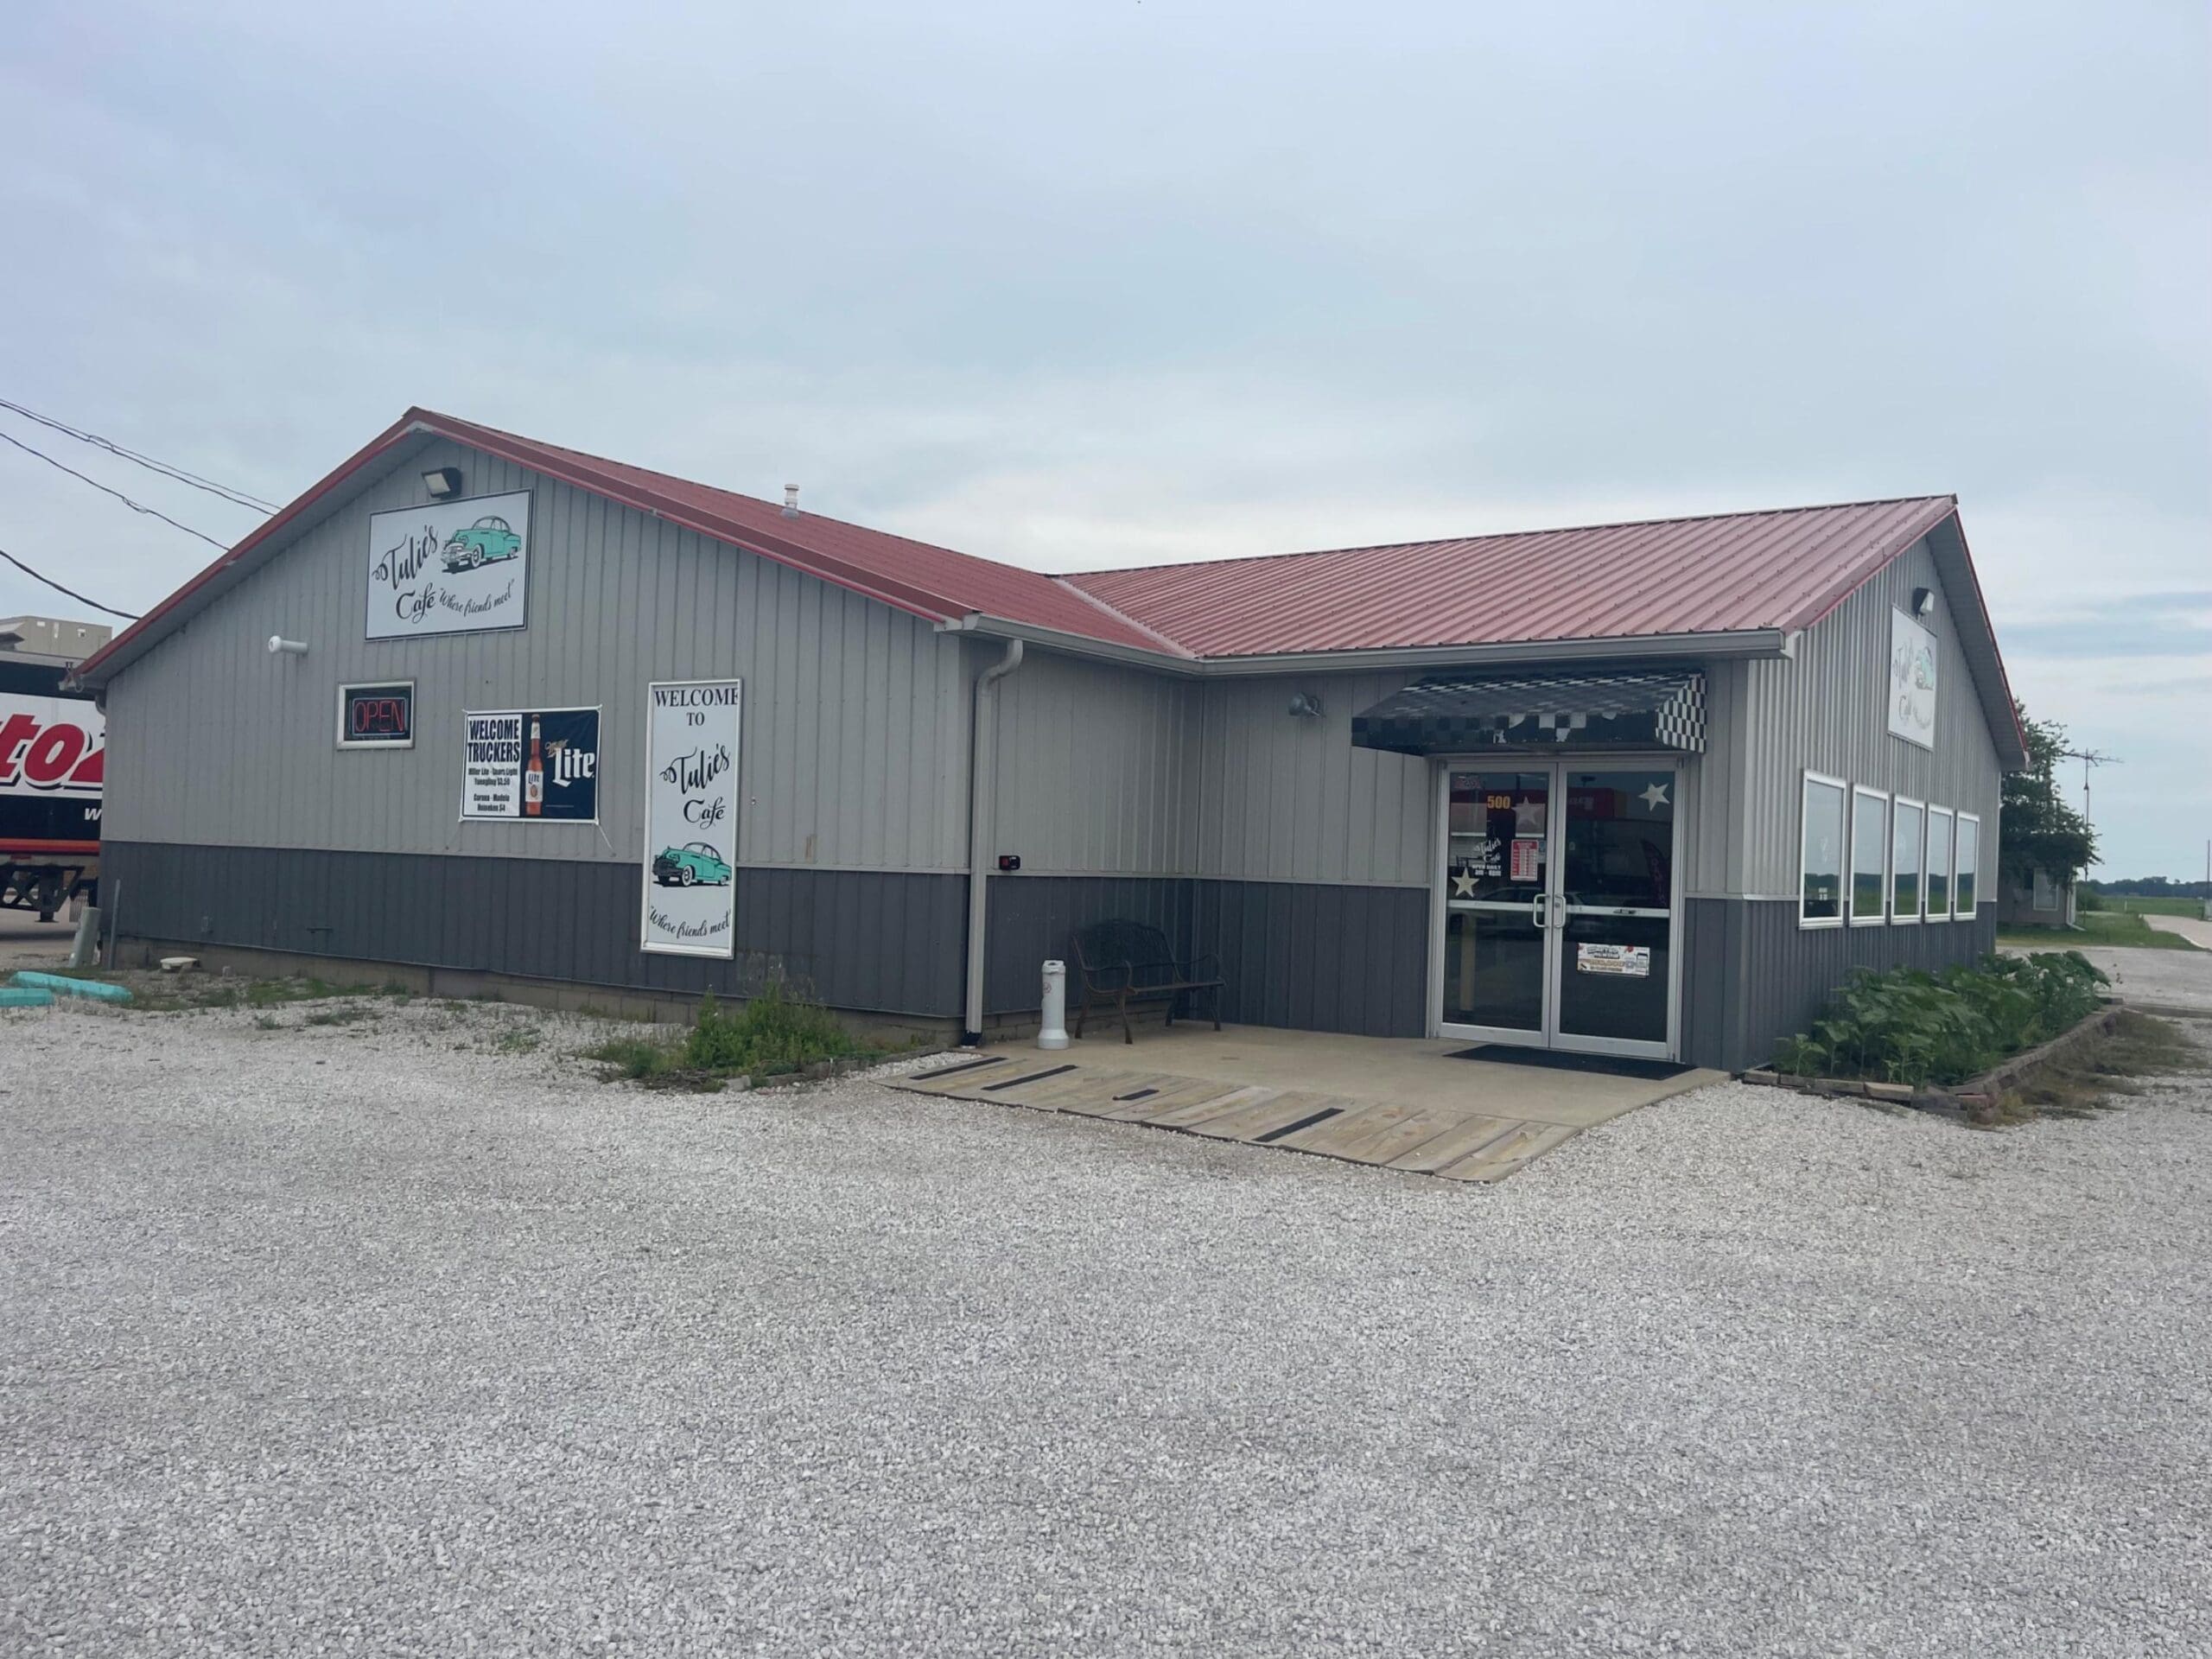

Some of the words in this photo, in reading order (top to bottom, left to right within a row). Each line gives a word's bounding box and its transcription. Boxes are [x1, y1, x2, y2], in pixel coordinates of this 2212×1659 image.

[464, 594, 492, 617] friends
[654, 687, 739, 708] WELCOME
[354, 700, 404, 733] OPEN
[686, 711, 705, 727] TO
[469, 719, 520, 741] WELCOME
[467, 741, 520, 763] TRUCKERS
[552, 747, 595, 787] Lite
[1487, 796, 1510, 810] 500
[677, 919, 708, 939] friends
